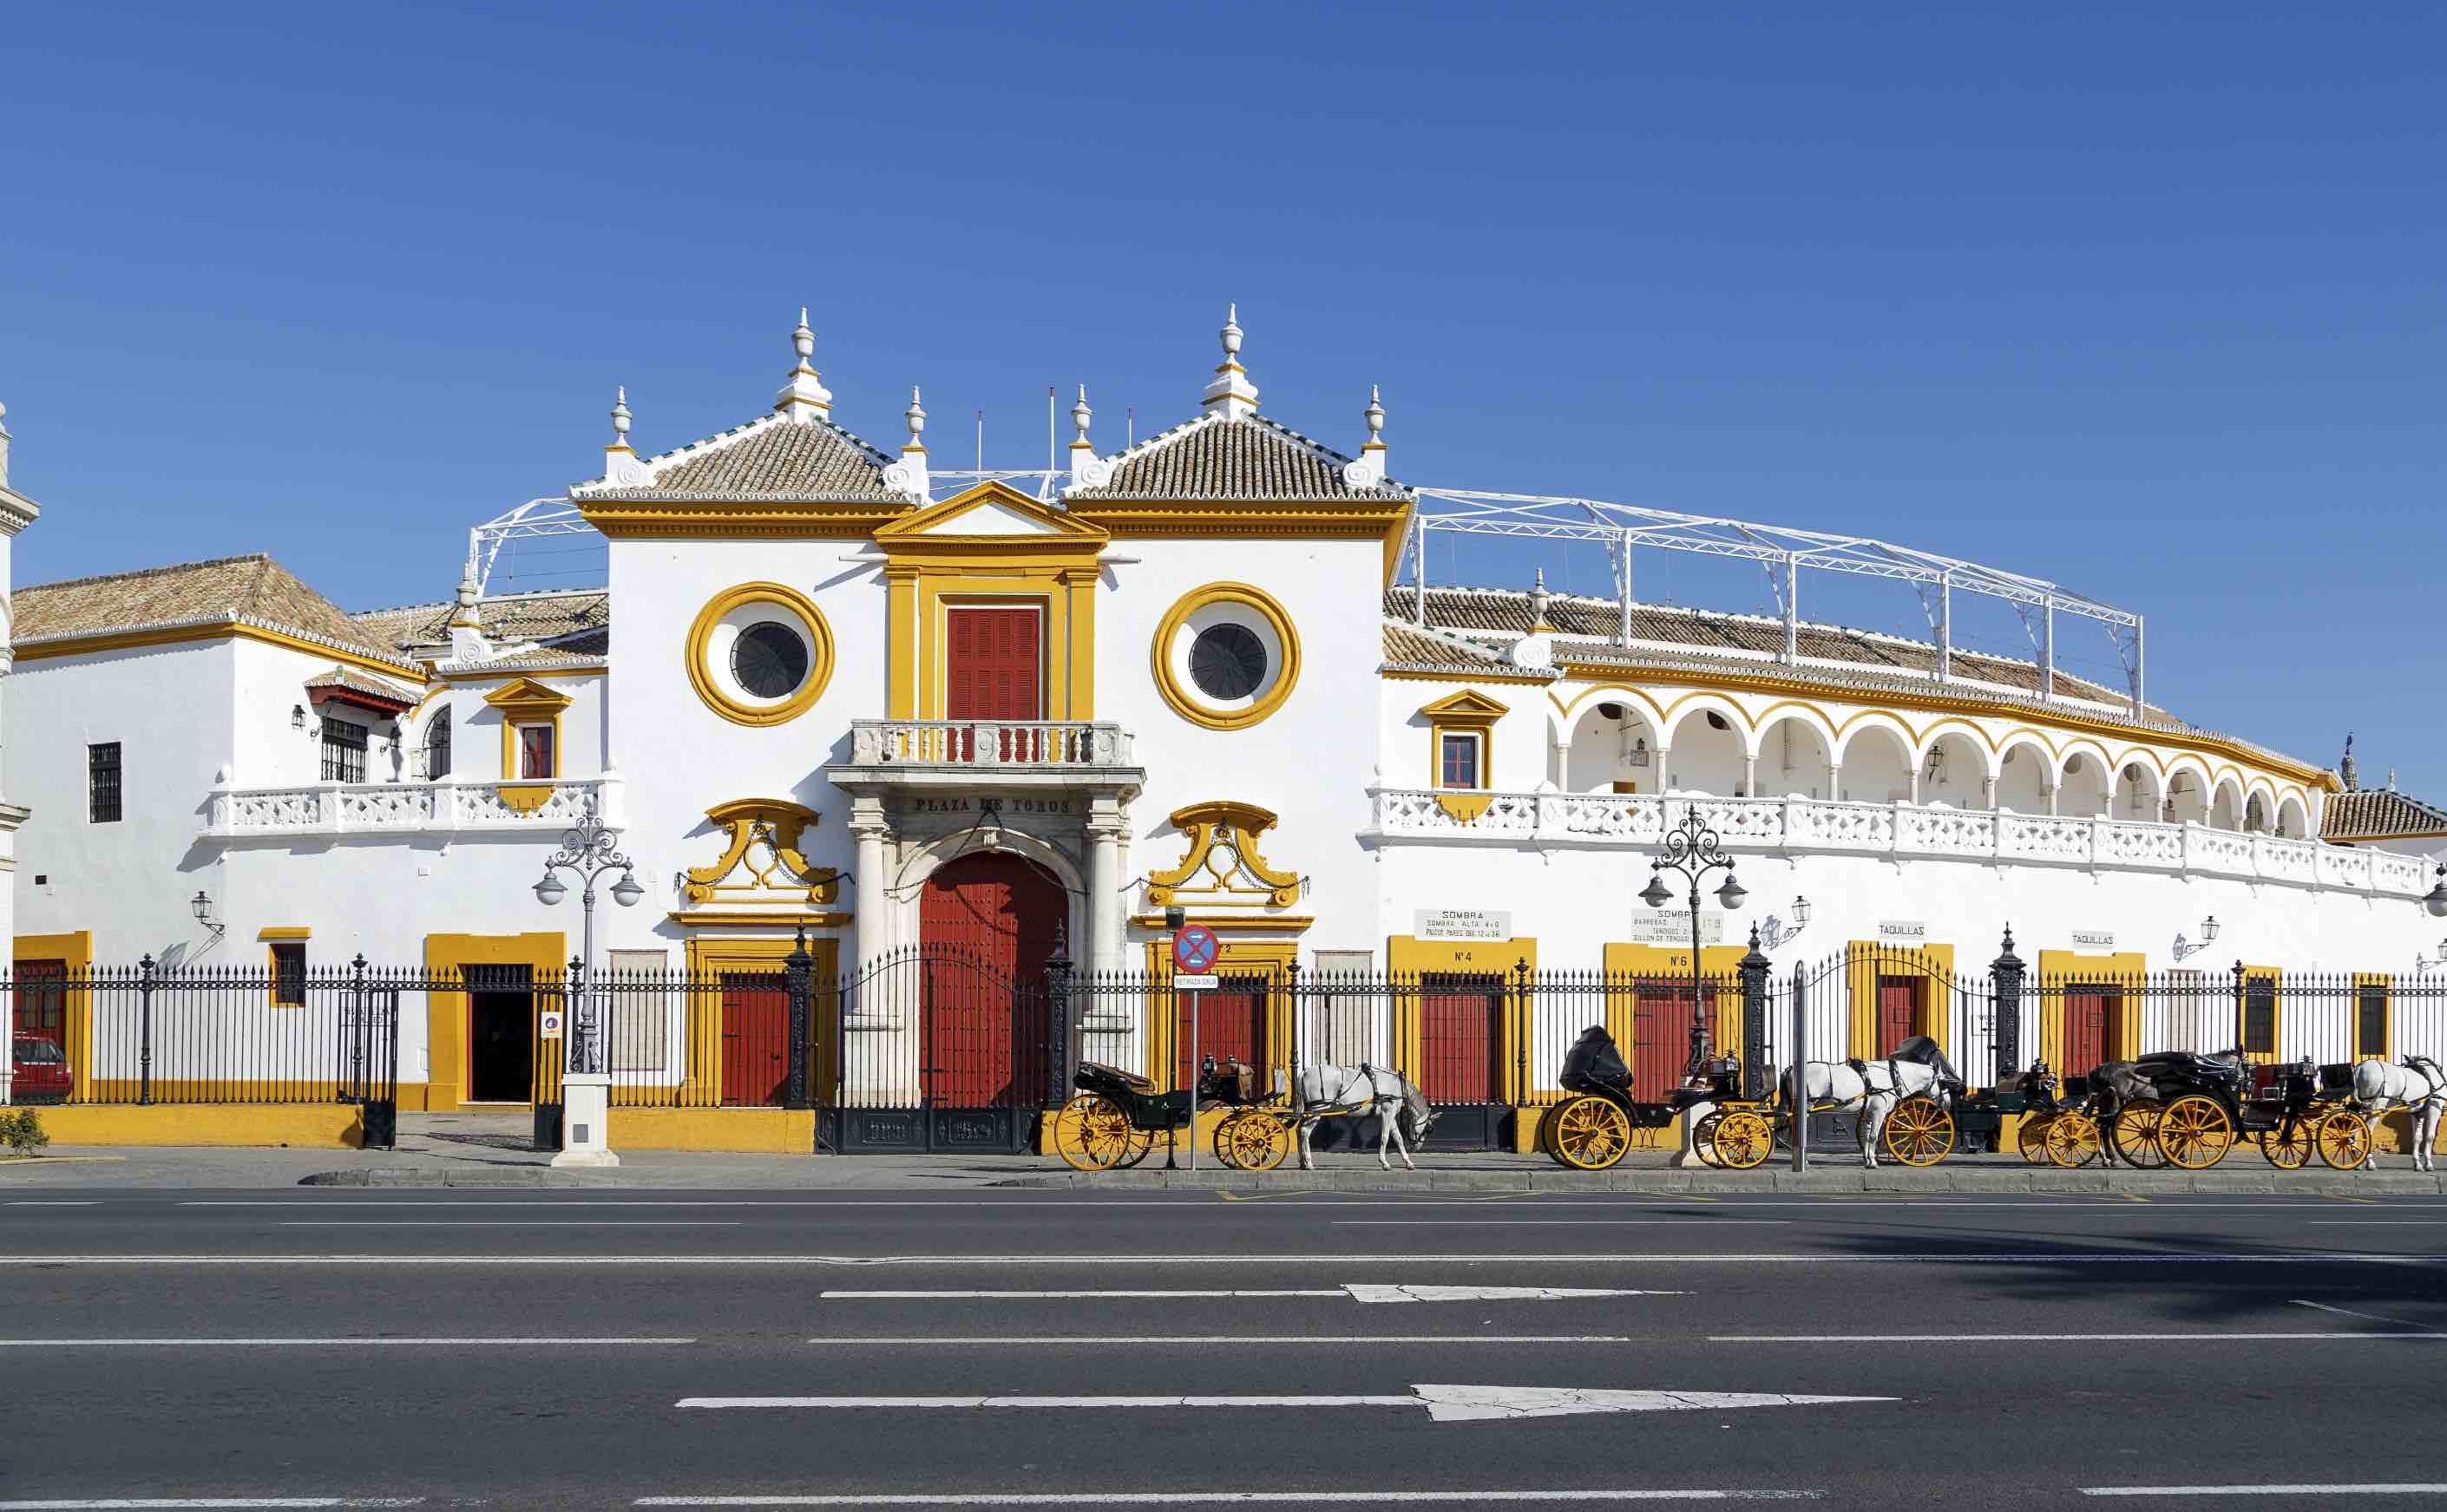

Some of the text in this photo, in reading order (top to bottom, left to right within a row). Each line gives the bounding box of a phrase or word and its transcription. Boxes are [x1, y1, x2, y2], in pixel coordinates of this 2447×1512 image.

[915, 797, 971, 811] PLAZA
[1013, 798, 1070, 813] TOROS
[1879, 925, 1924, 935] TAQUILLAS
[2072, 935, 2114, 945] TAQUILLAS
[1465, 952, 1472, 962] 4
[1680, 956, 1687, 966] 6
